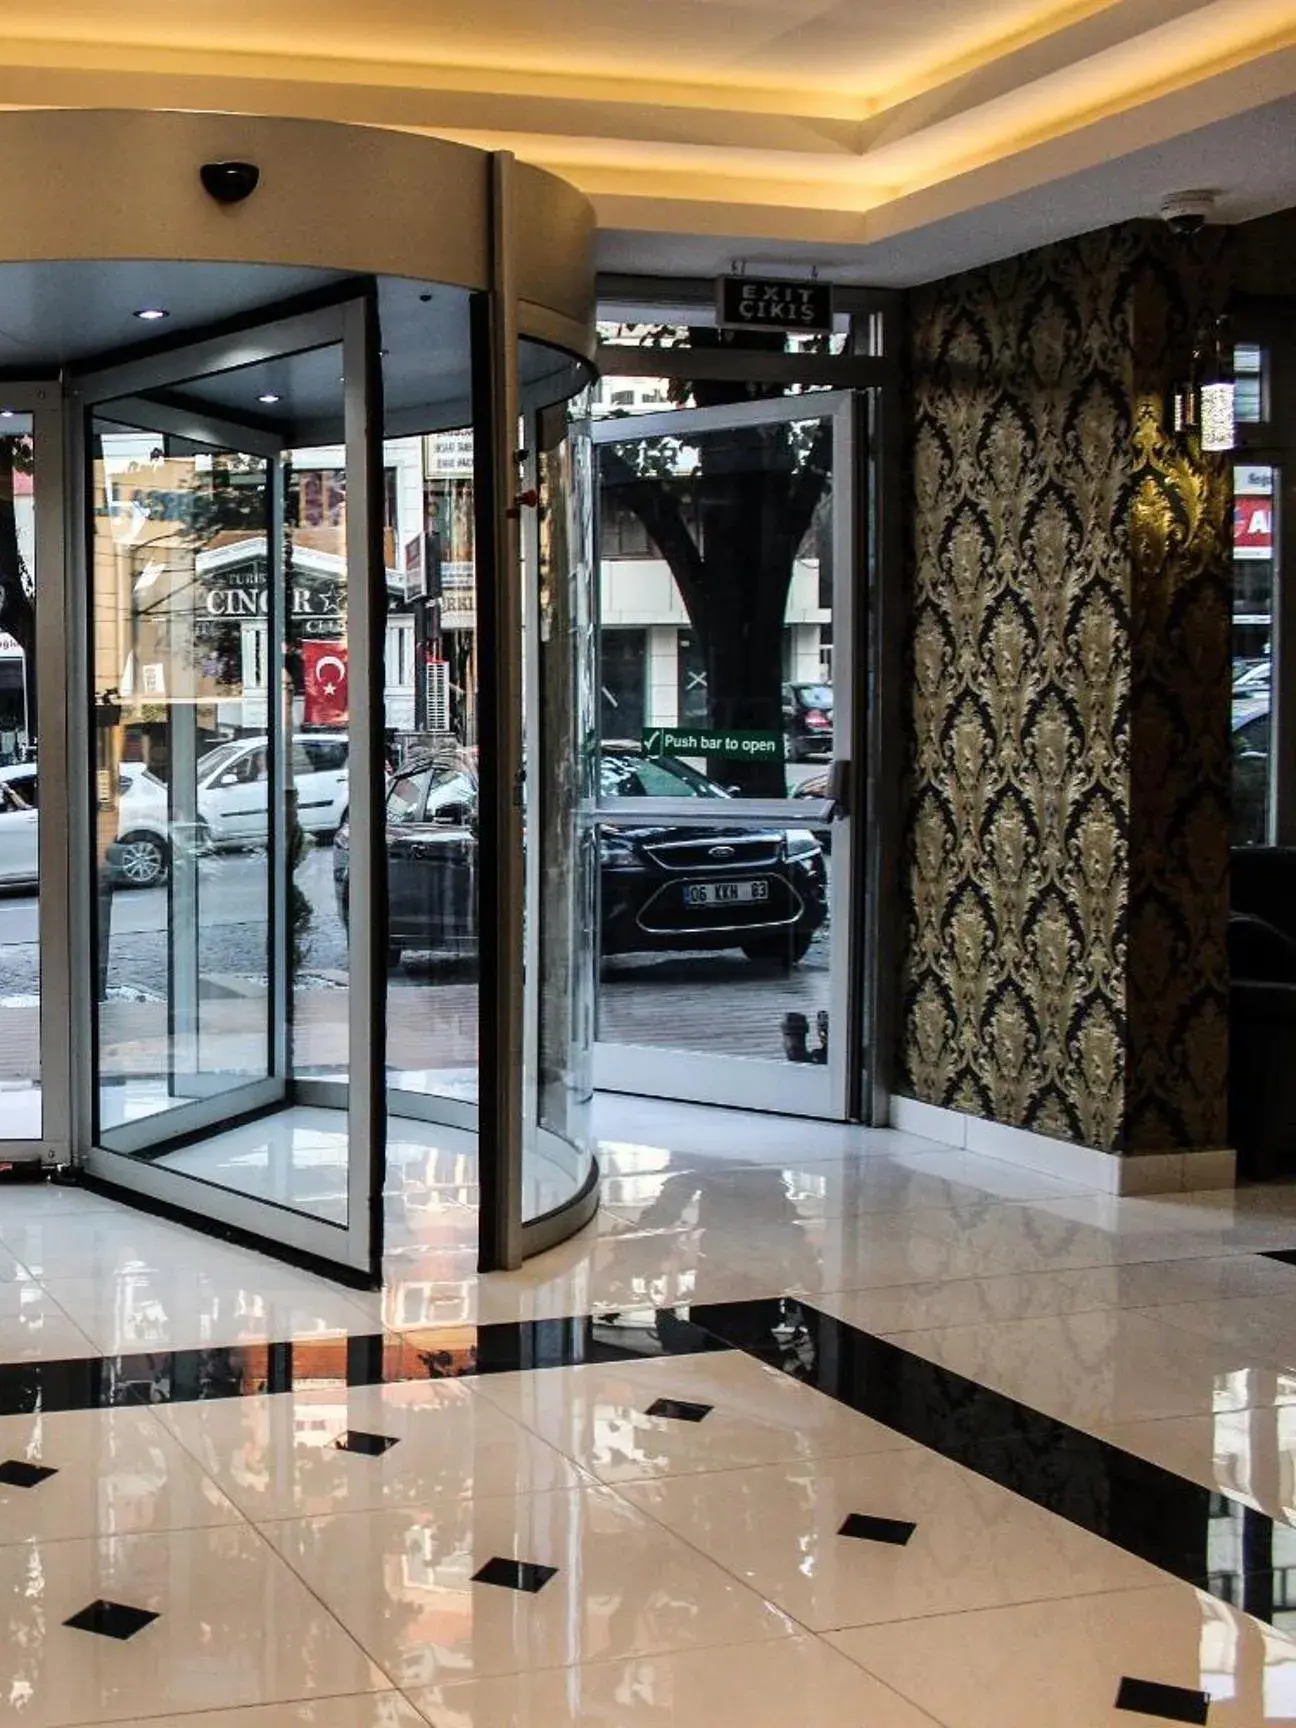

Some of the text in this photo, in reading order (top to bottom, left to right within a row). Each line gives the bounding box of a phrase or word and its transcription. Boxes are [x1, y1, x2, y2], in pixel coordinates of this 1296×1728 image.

[742, 284, 814, 303] EXIT
[664, 733, 776, 754] Push bar to open
